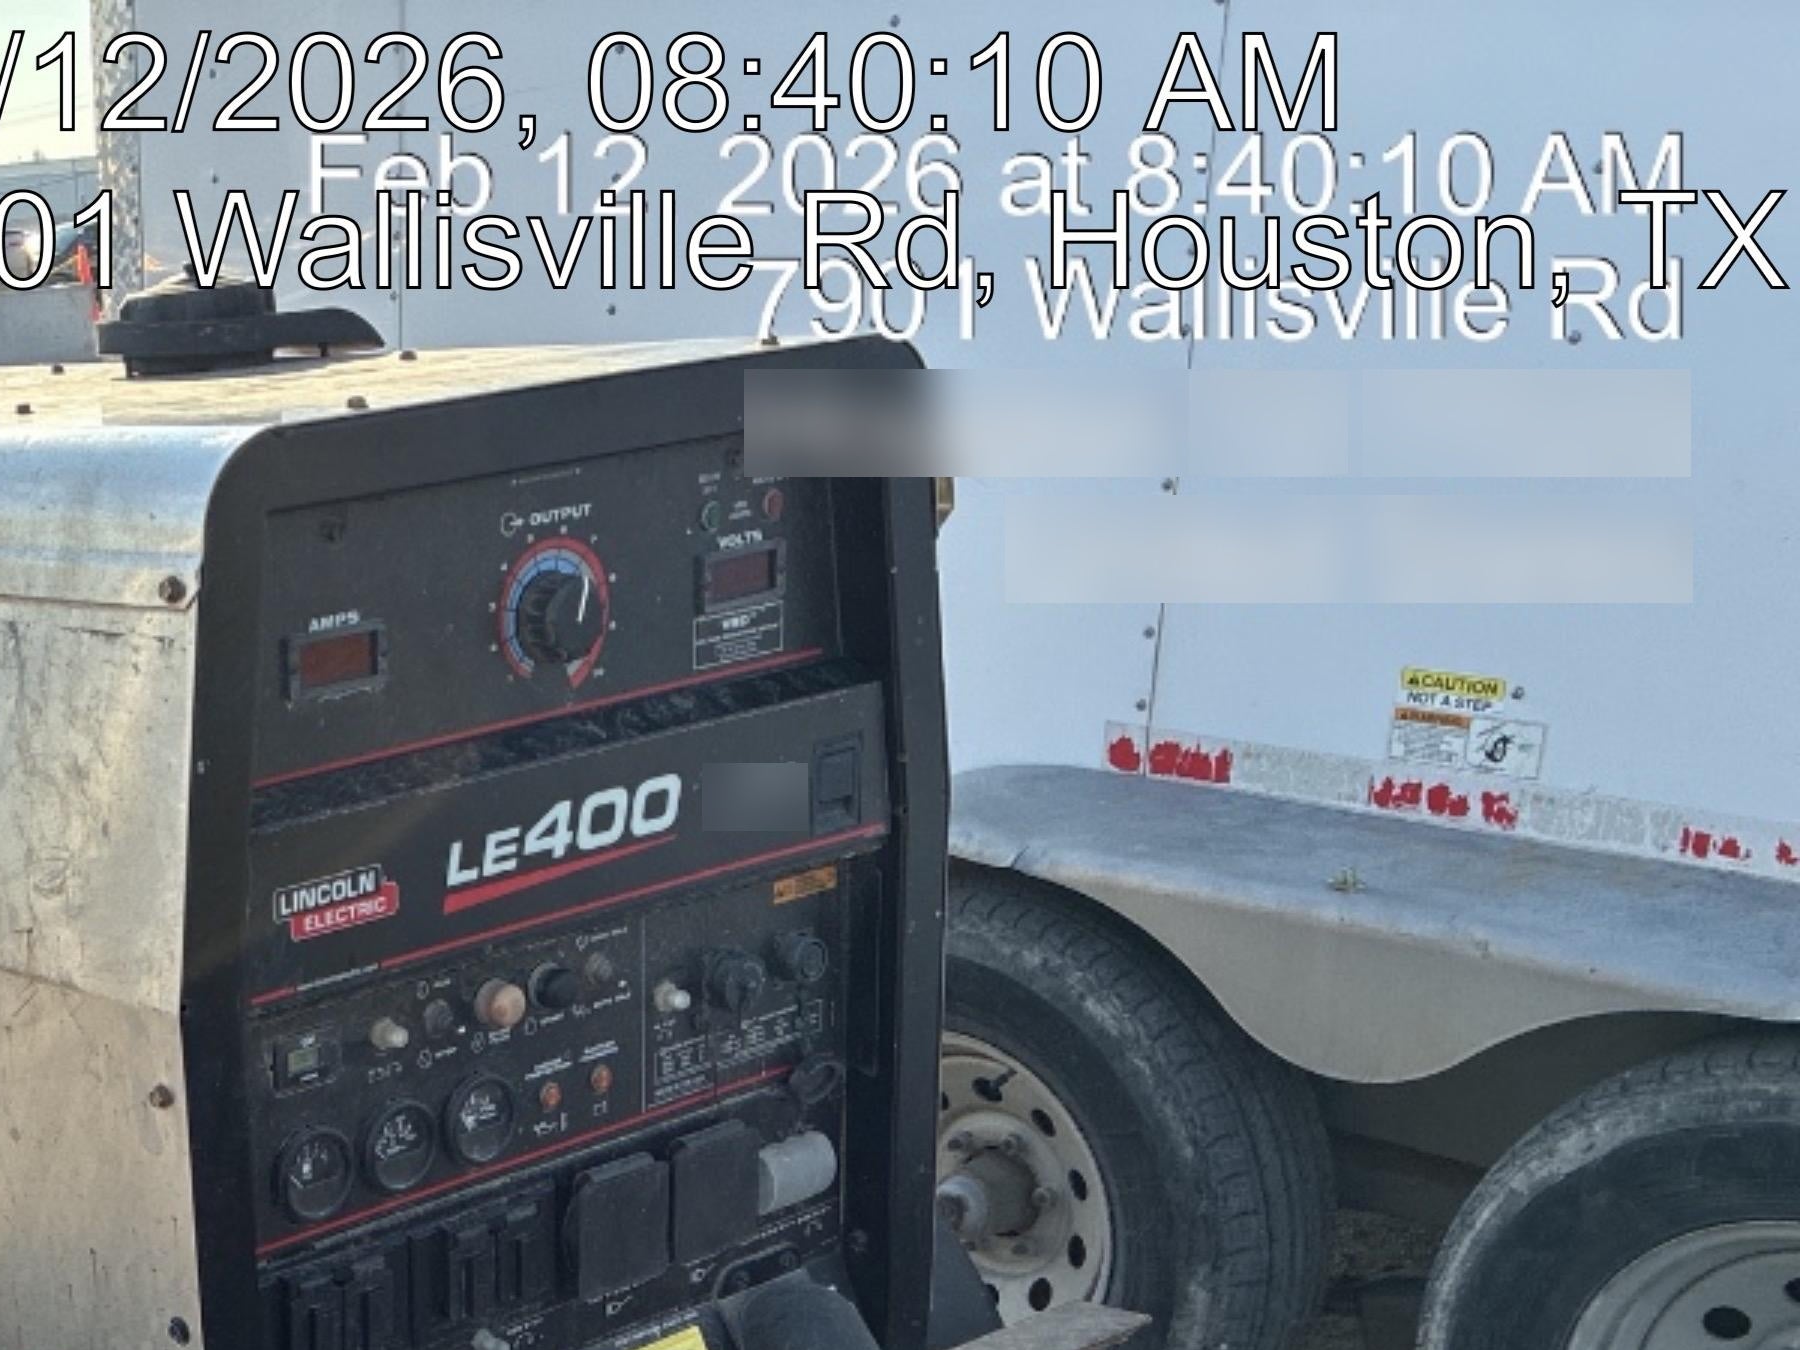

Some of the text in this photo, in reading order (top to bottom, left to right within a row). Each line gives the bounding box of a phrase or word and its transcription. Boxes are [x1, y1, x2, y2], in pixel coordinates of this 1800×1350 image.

[530, 503, 593, 527] OUTPUT
[717, 528, 764, 550] VOLTS
[309, 609, 362, 634] AMPS
[1422, 674, 1498, 696] CAUTION
[1406, 691, 1492, 712] NOT A STEP
[446, 773, 683, 887] LE400
[280, 869, 377, 917] LINCOLN
[304, 896, 388, 933] ELECTRIC
